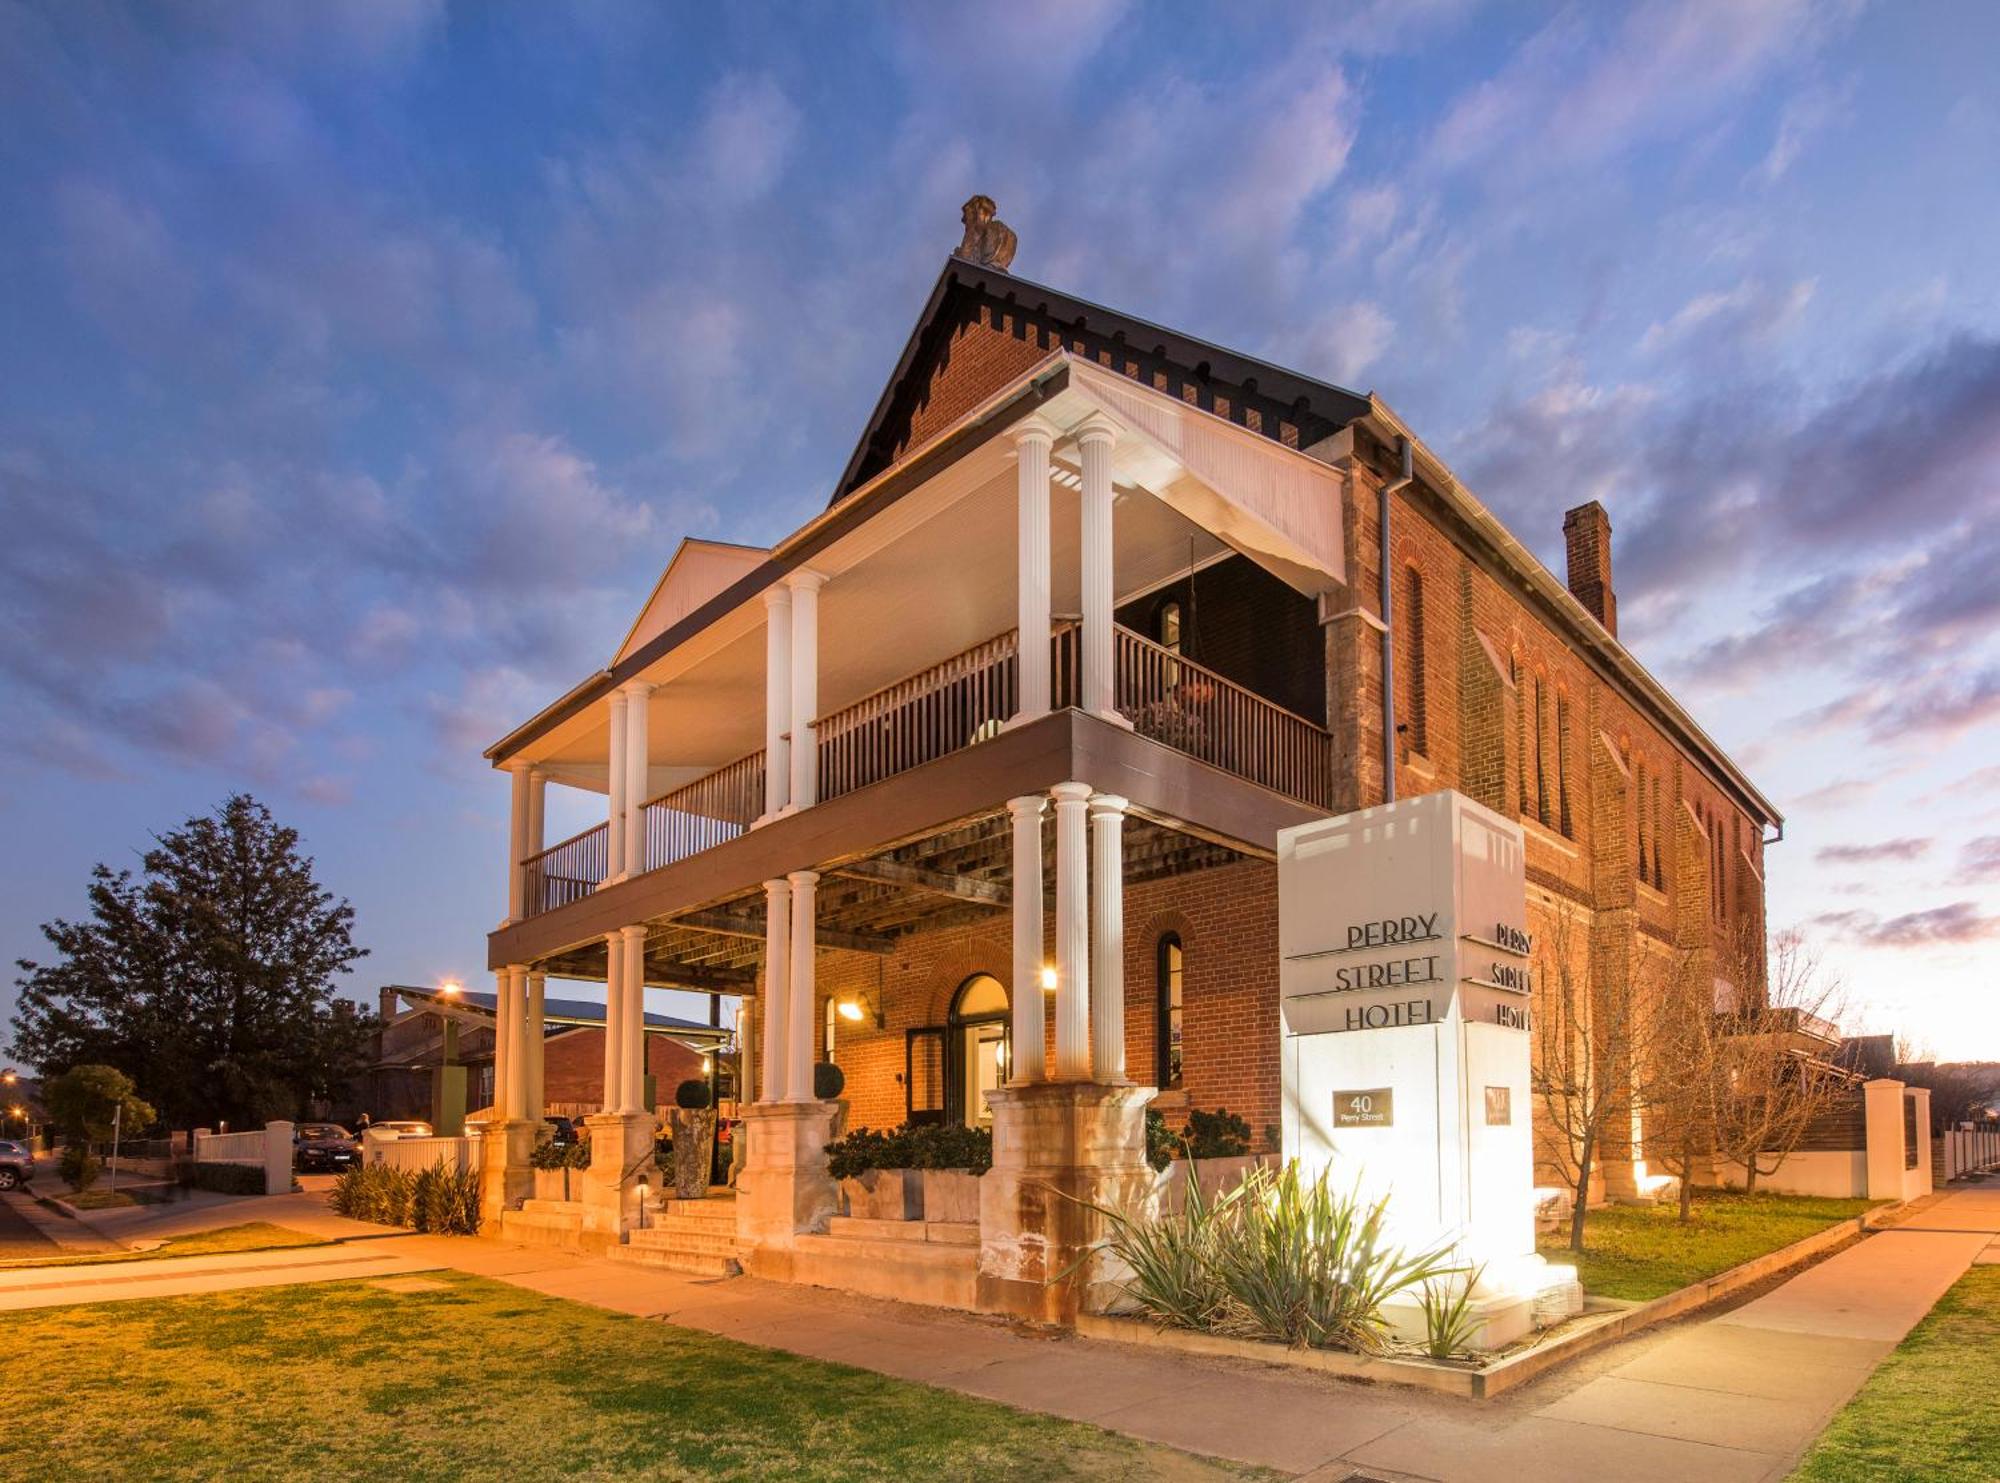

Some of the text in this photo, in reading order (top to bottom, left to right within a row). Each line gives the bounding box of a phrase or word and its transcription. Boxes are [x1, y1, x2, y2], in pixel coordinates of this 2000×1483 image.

[1347, 912, 1438, 949] PERRY
[1336, 956, 1440, 991] STREET
[1346, 1000, 1436, 1030] HOTEL
[1350, 1095, 1372, 1113] 40
